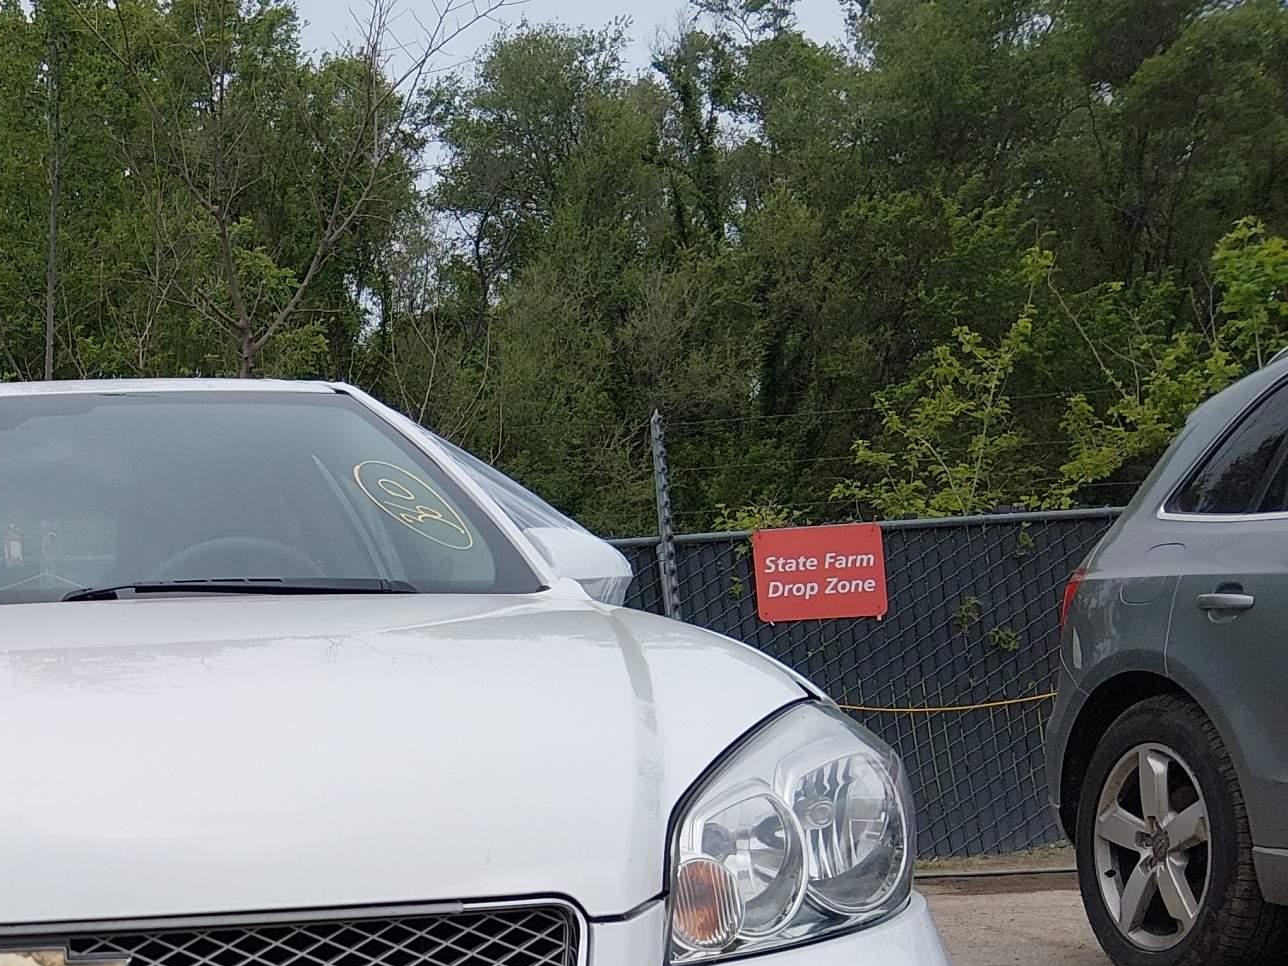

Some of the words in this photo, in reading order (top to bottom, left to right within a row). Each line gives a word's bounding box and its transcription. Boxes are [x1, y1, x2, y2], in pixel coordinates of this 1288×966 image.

[764, 556, 818, 573] State
[825, 553, 874, 569] Farm
[768, 581, 819, 599] Drop
[825, 578, 876, 594] Zone
